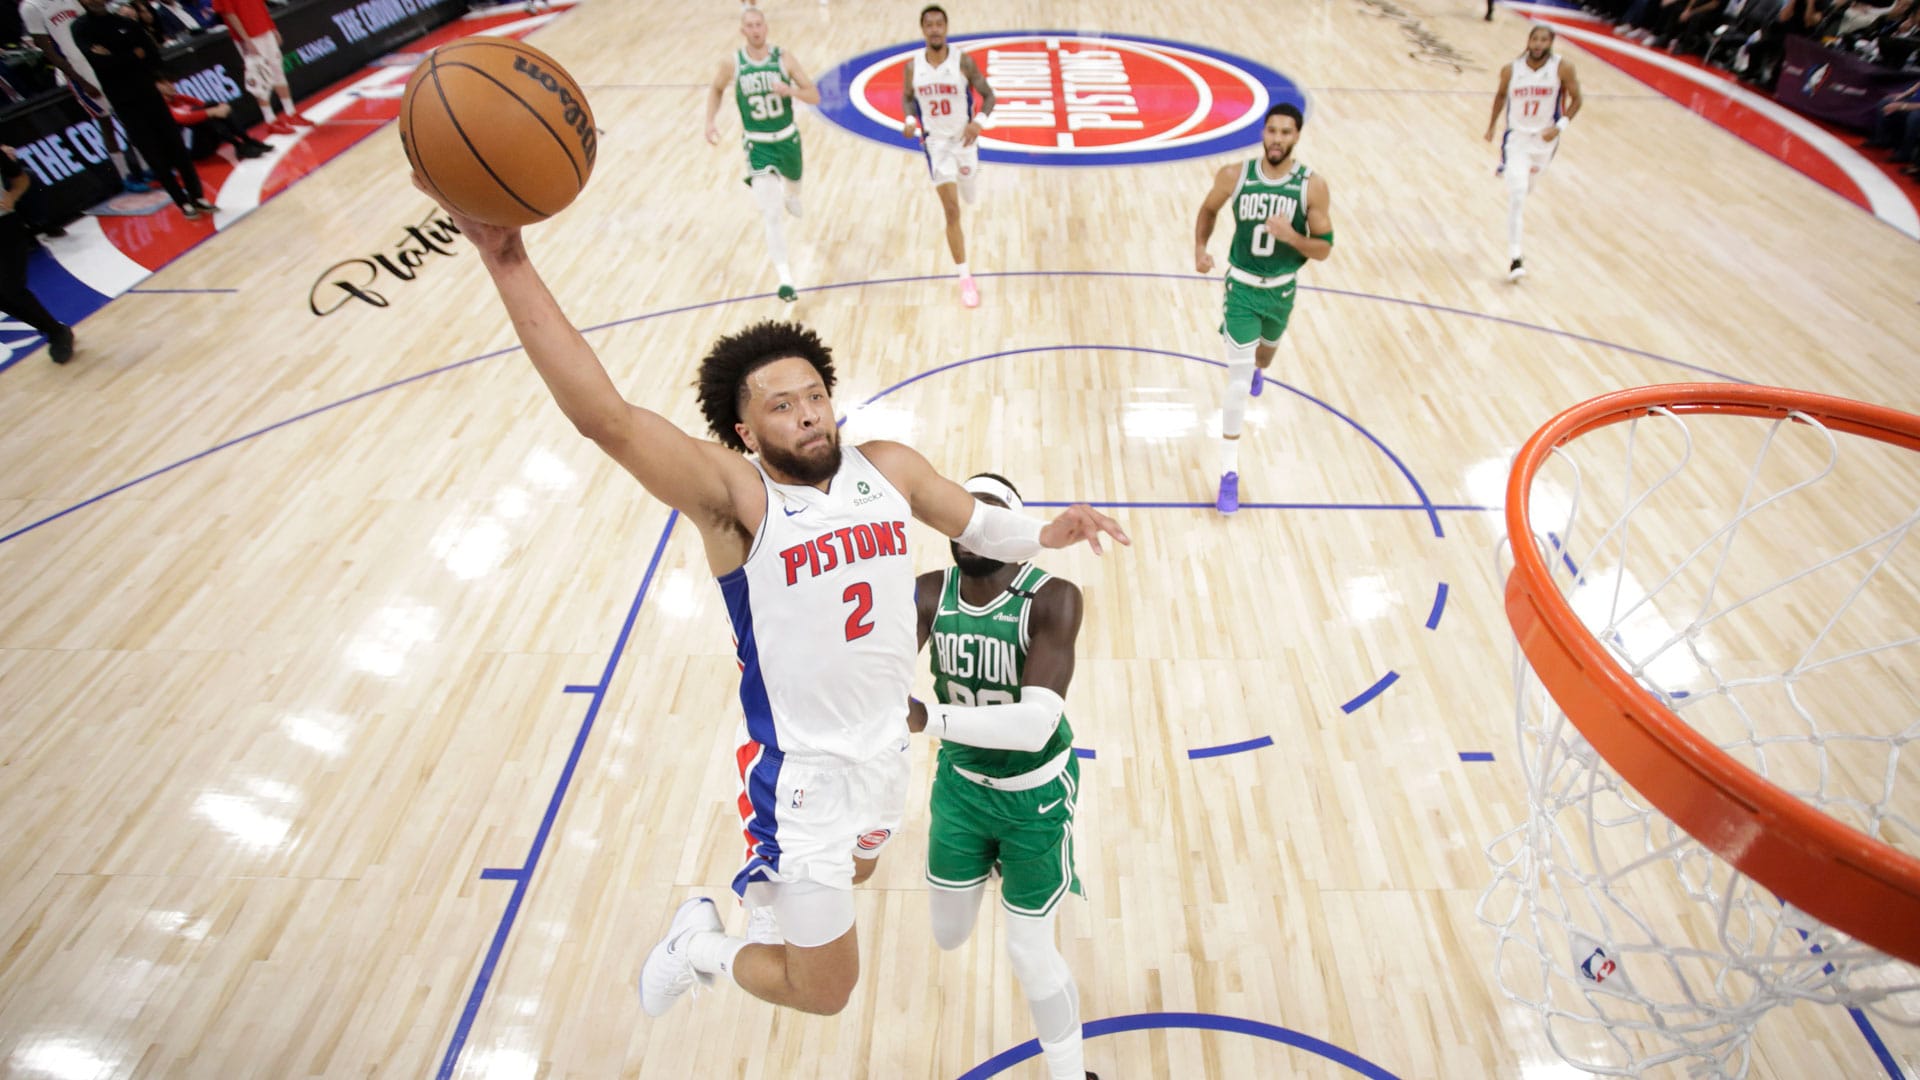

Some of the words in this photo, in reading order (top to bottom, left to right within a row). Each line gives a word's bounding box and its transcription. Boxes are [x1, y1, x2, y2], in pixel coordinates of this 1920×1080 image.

[331, 8, 368, 44] THE
[748, 93, 784, 120] 30
[929, 99, 951, 116] 20
[981, 50, 1057, 129] DETROIT
[1058, 50, 1144, 131] PISTONS
[1524, 101, 1539, 116] 17
[15, 134, 86, 186] THE
[1251, 223, 1276, 257] 0
[779, 520, 907, 587] PISTONS
[842, 581, 875, 642] 2
[934, 631, 1018, 686] BOSTON
